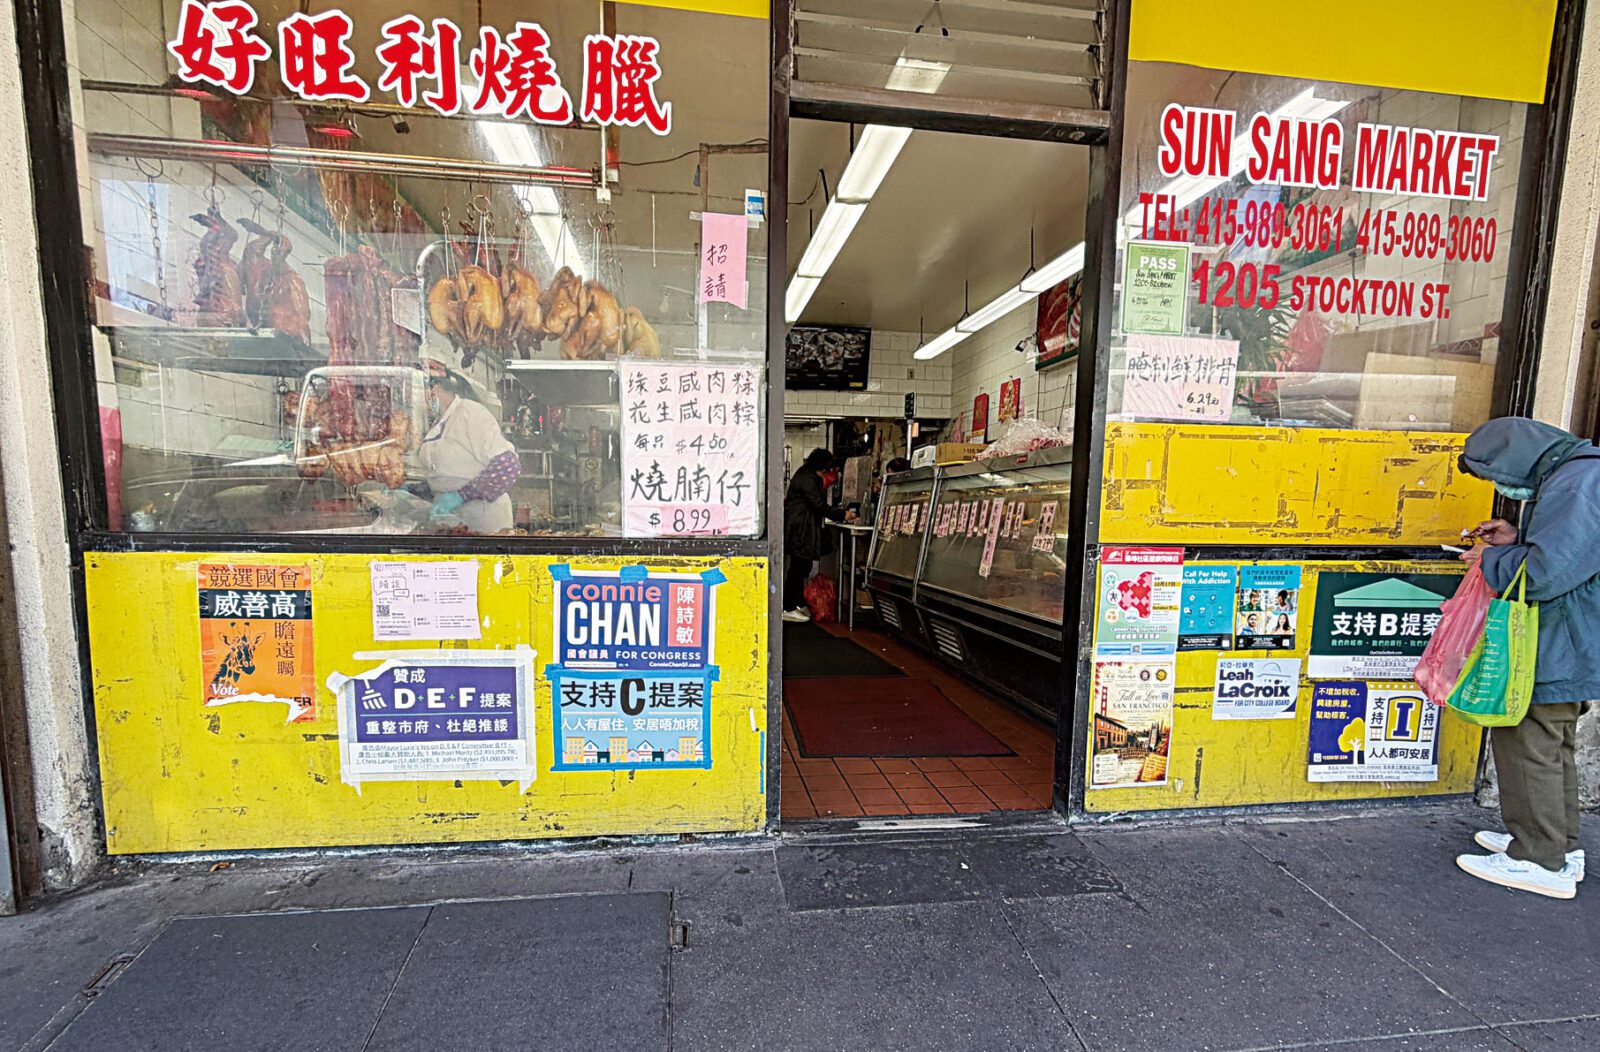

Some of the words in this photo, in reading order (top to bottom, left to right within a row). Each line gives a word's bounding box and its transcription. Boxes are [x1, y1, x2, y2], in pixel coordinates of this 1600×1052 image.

[1159, 102, 1236, 179] SUN
[1246, 112, 1343, 191] SANG
[1352, 123, 1500, 201] MARKET
[1139, 193, 1188, 242] TEL:
[1194, 197, 1343, 254] 415-989-3061
[1357, 208, 1497, 263] 415-989-3060
[704, 244, 728, 298] 招請
[1140, 256, 1177, 271] PASS
[1192, 260, 1280, 310] 1205
[1290, 275, 1416, 318] STOCKTON
[1420, 283, 1450, 319] ST.
[208, 567, 300, 588] 競選國會
[1198, 577, 1231, 585] Addiction
[1212, 570, 1228, 578] Help
[213, 591, 298, 618] 威善高
[675, 586, 695, 644] 陳詩敏
[566, 601, 661, 646] CHAN
[274, 620, 295, 677] 瞻遠矚
[616, 650, 638, 660] FOR
[640, 651, 701, 660] CONGRESS
[1219, 669, 1254, 681] Leah
[211, 682, 240, 696] Vote
[560, 677, 703, 716] 支持C提案
[1218, 680, 1291, 698] LaCroix
[1370, 697, 1386, 725] 支持
[1369, 747, 1430, 760] 人人都可安居
